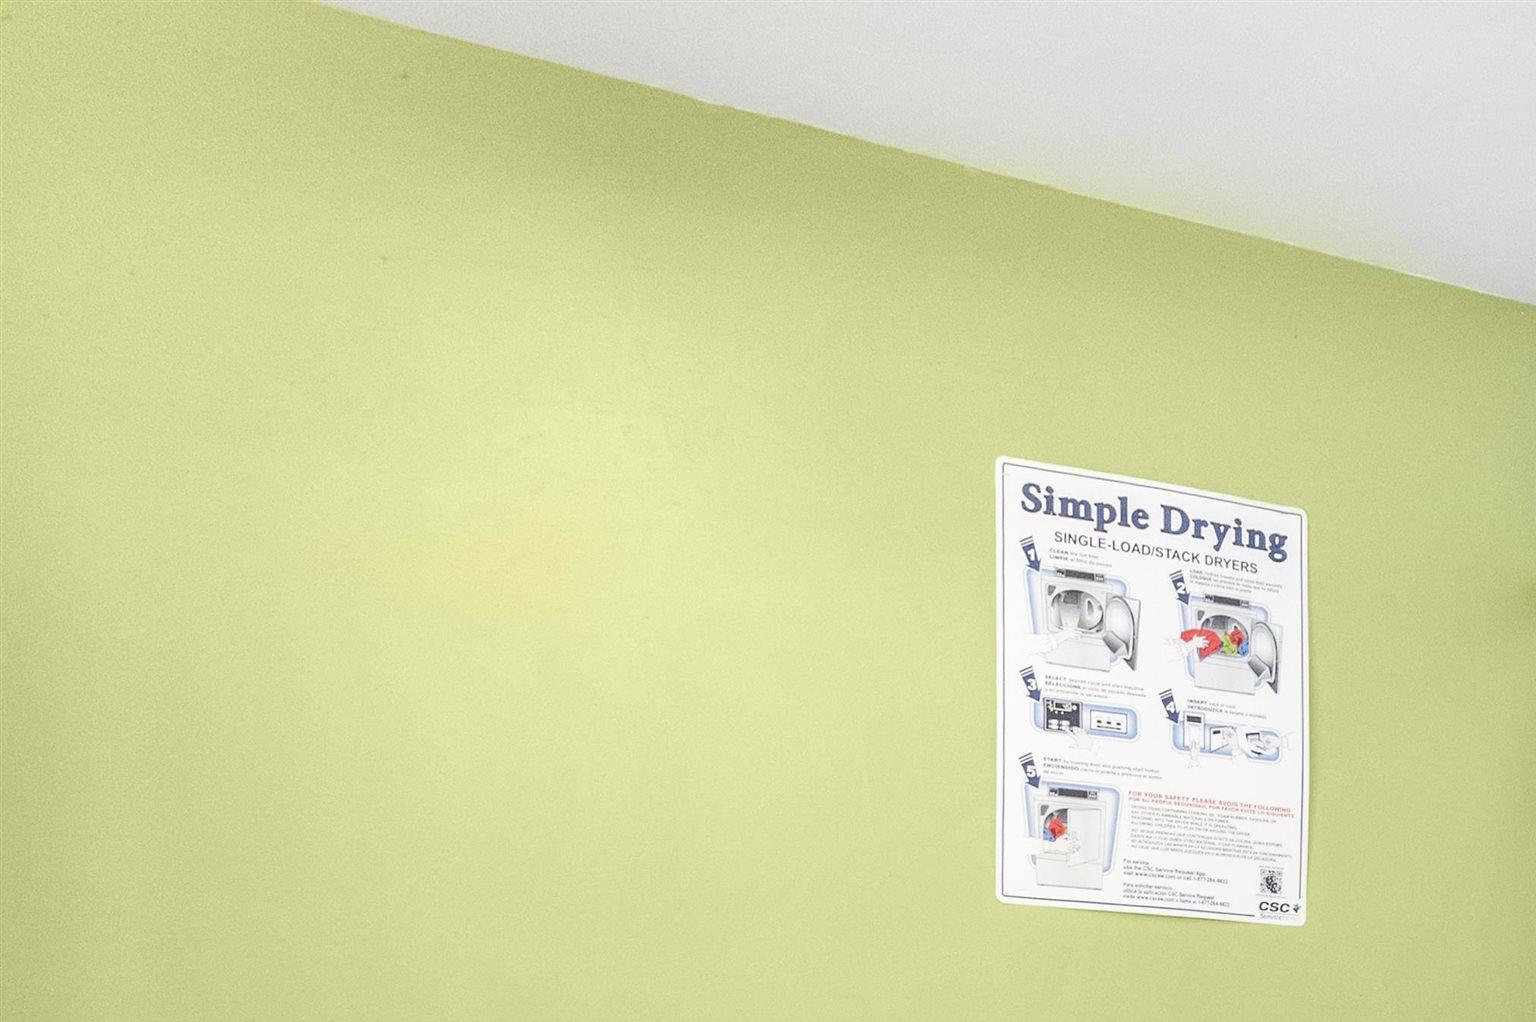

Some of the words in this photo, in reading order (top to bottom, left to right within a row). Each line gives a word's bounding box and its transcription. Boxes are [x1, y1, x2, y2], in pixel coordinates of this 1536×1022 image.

[1021, 482, 1149, 533] Simple
[1160, 504, 1288, 562] Drying
[1054, 531, 1200, 564] SINGLE-LOAD/STACK
[1205, 554, 1259, 574] DRYERS
[1176, 582, 1187, 594] 2
[1027, 678, 1037, 690] 3
[1026, 765, 1037, 777] 5
[1254, 804, 1292, 813] FOLLOWING
[1259, 901, 1290, 913] CSC
